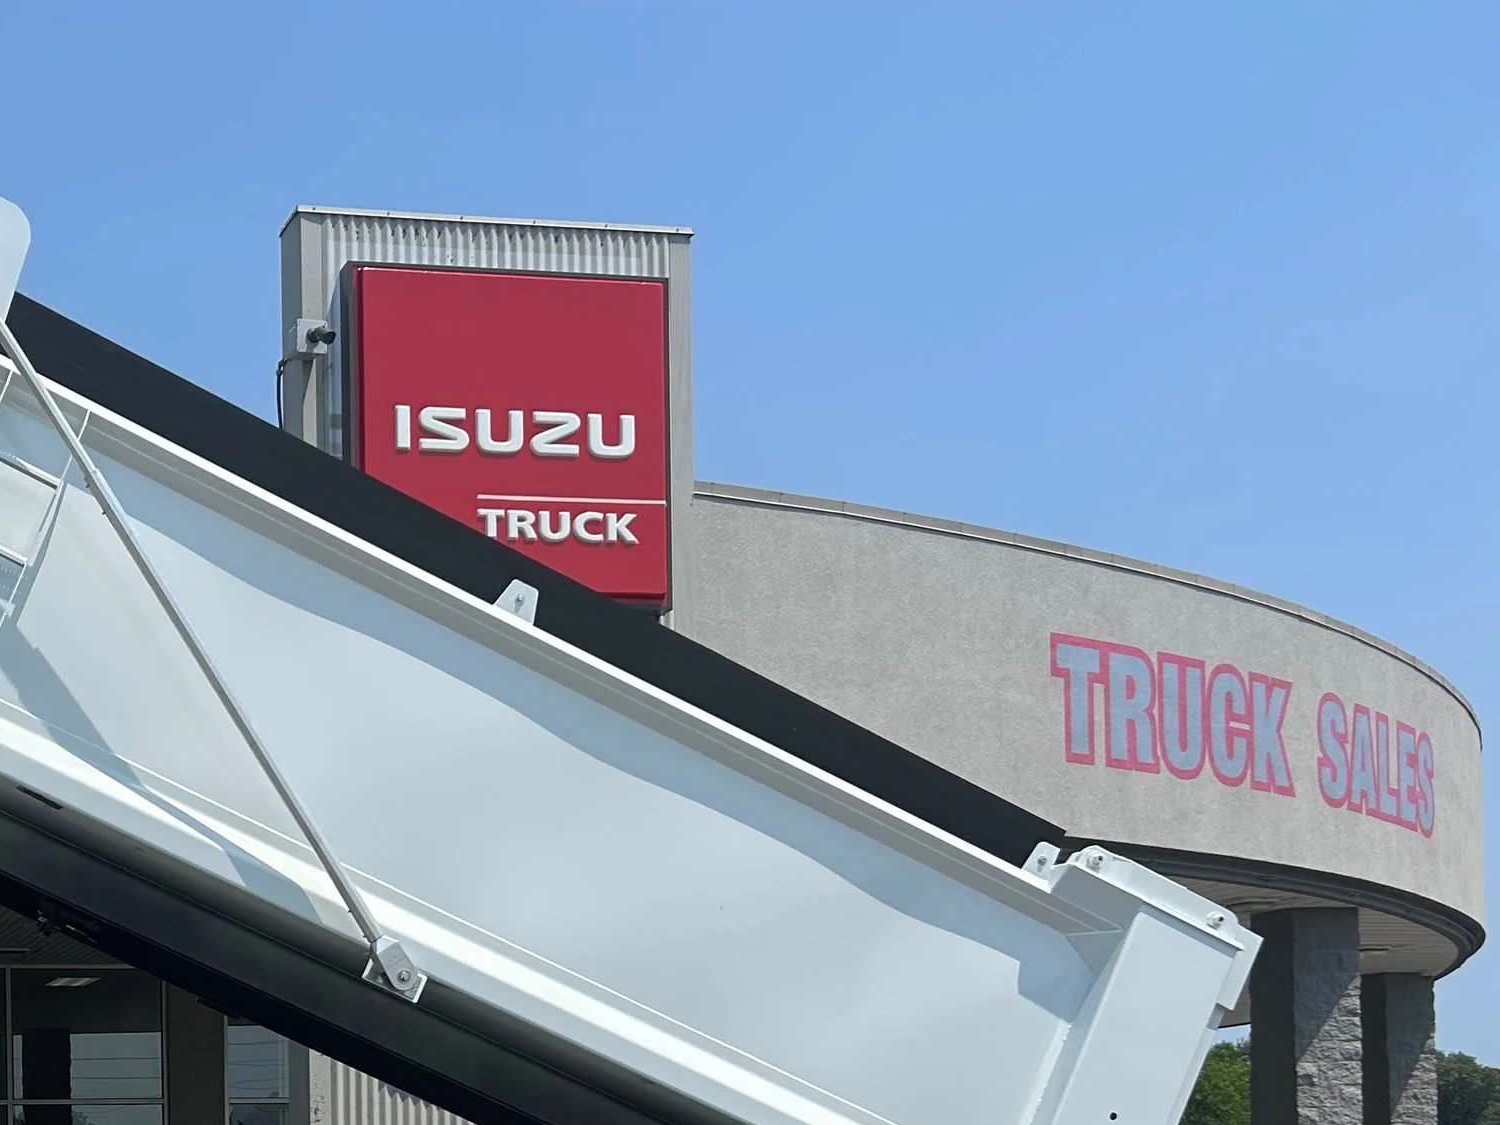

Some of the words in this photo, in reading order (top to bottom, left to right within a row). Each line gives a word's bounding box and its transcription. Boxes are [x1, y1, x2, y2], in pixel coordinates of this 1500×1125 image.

[394, 404, 636, 459] ISUZU
[477, 507, 640, 545] TRUCK
[1050, 632, 1296, 798] TRUCK
[1316, 692, 1436, 838] SALES
